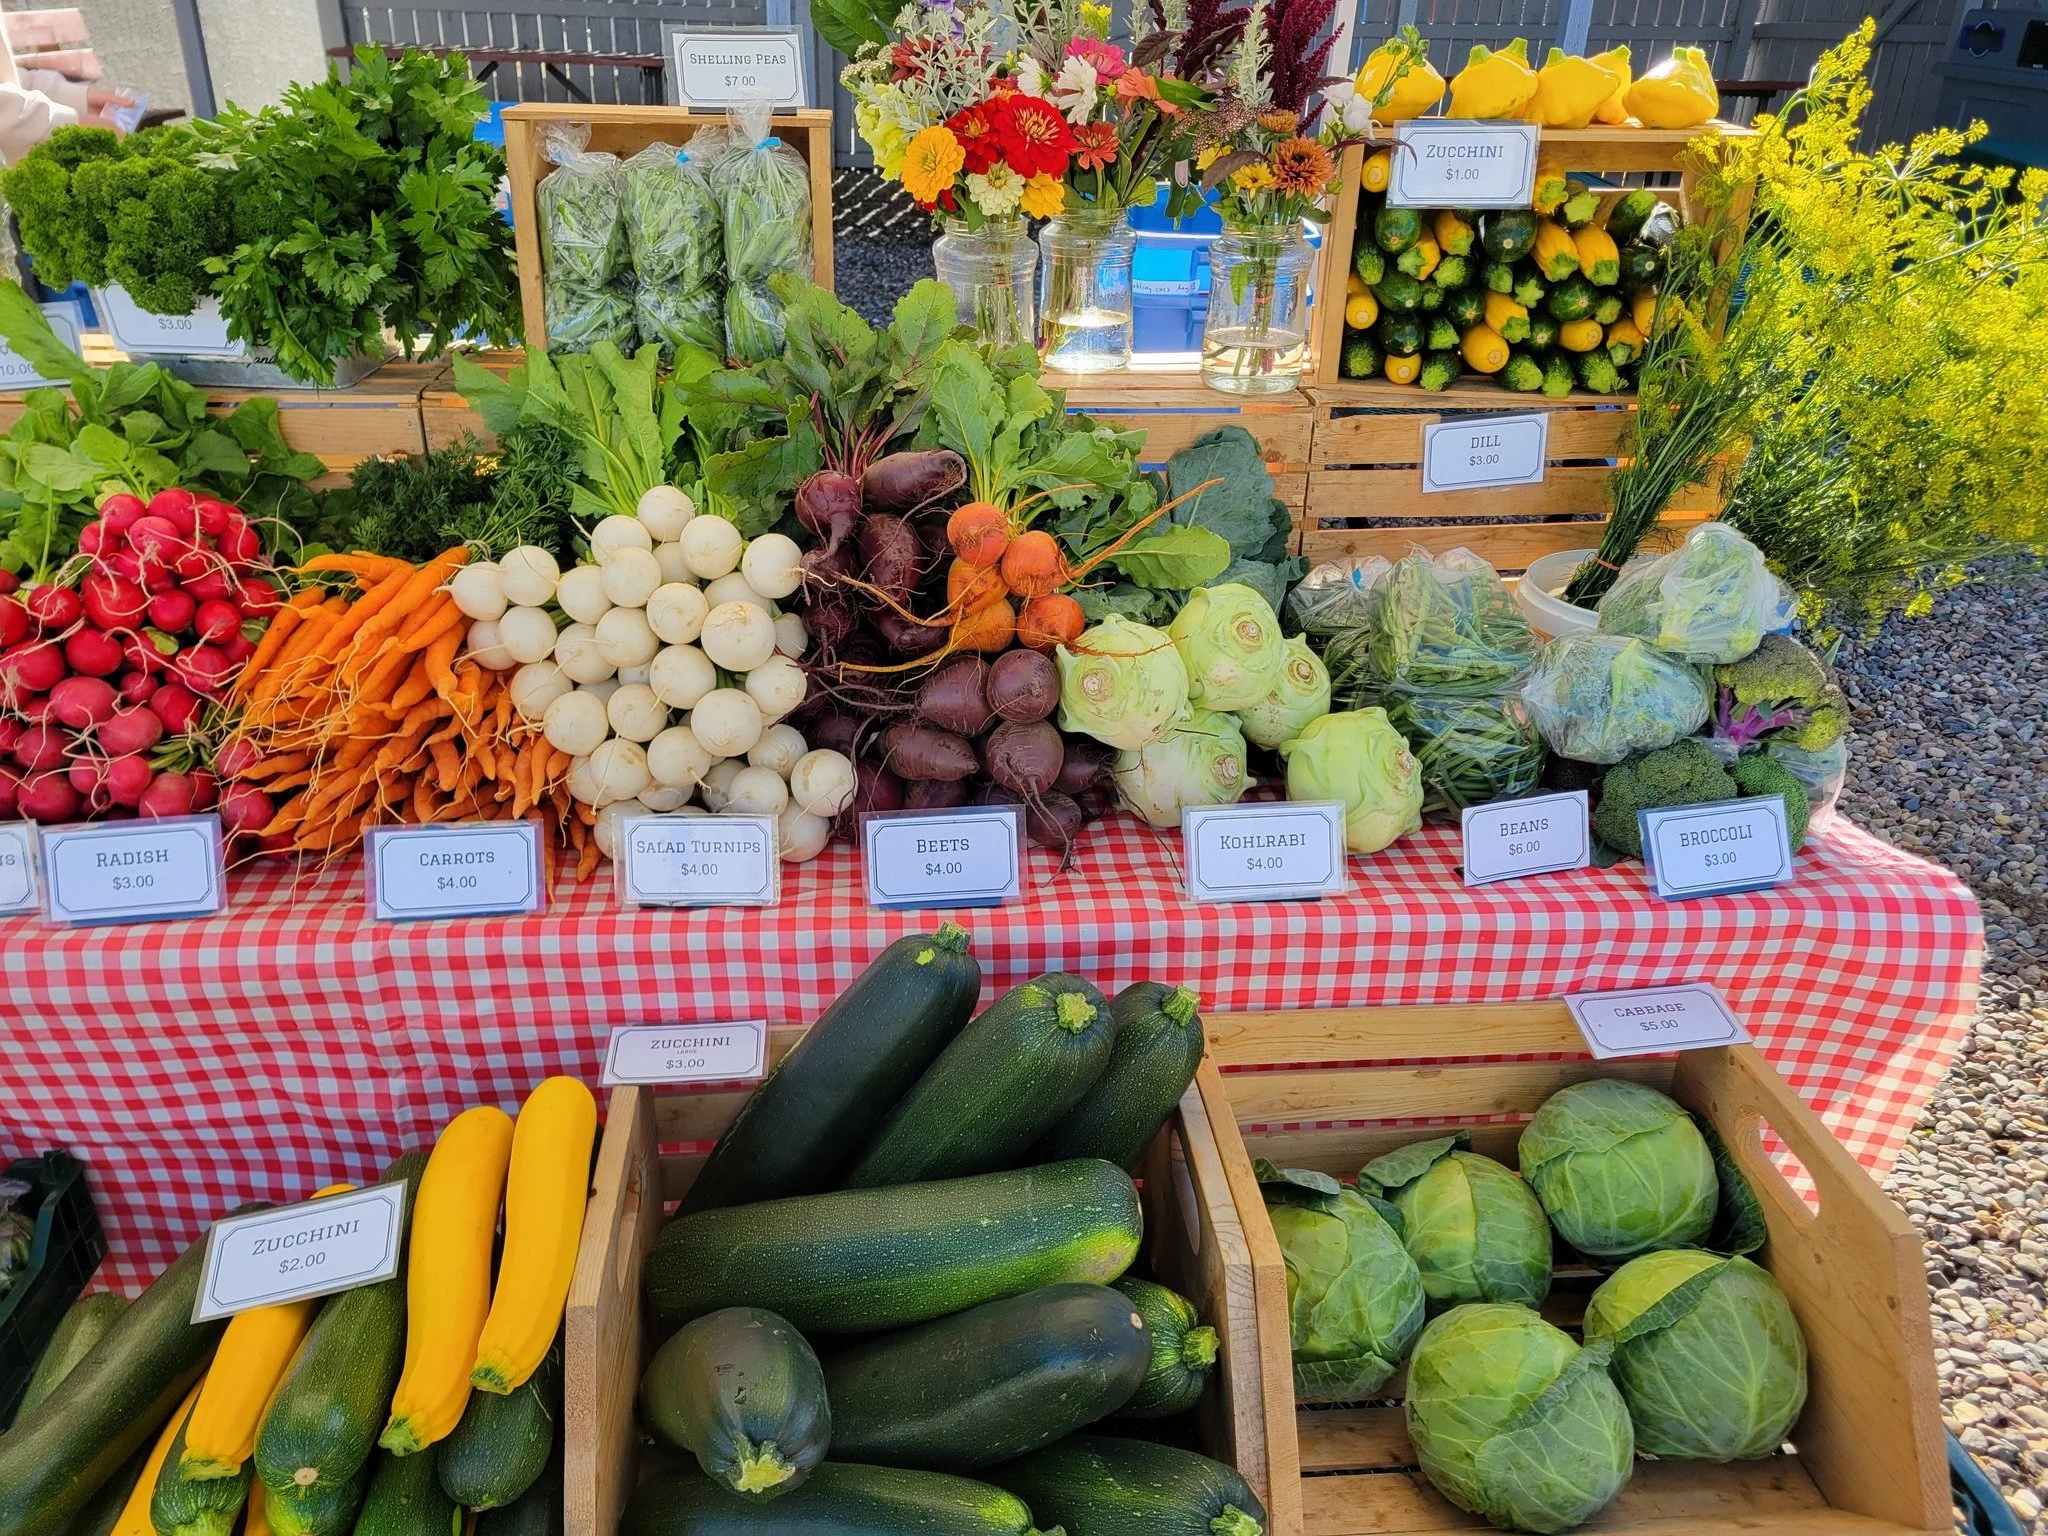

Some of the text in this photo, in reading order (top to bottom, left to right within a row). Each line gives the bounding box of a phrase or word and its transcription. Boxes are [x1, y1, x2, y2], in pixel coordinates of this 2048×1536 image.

[690, 53, 786, 65] SHELLING PEAS
[725, 75, 756, 87] $7.00
[1426, 145, 1504, 158] ZUCCHINI
[1446, 168, 1479, 180] $1.00
[158, 319, 192, 330] $3.00
[1471, 435, 1501, 449] DILL
[1469, 454, 1499, 467] $3.00
[1500, 818, 1549, 837] BEANS
[1220, 833, 1306, 849] KOHLRABI
[1680, 825, 1753, 847] BROCCOLI
[636, 840, 761, 854] SALAD TURNIPS
[916, 839, 970, 853] BEETS
[1509, 840, 1540, 856] $6.00
[96, 849, 169, 867] RADISH
[419, 851, 495, 867] CARROTS
[1246, 857, 1284, 871] $4.00
[1704, 851, 1737, 867] $3.00
[681, 863, 718, 876] $4.00
[925, 862, 962, 876] $4.00
[112, 875, 154, 890] $3.00
[437, 875, 477, 890] $4.00
[1613, 1002, 1686, 1018] CABBAGE
[1639, 1019, 1679, 1031] $5.00
[650, 1036, 731, 1050] ZUCCHINI
[665, 1058, 705, 1069] $3.00
[252, 1219, 360, 1255] ZUCCHINI
[278, 1252, 326, 1274] $2.00
